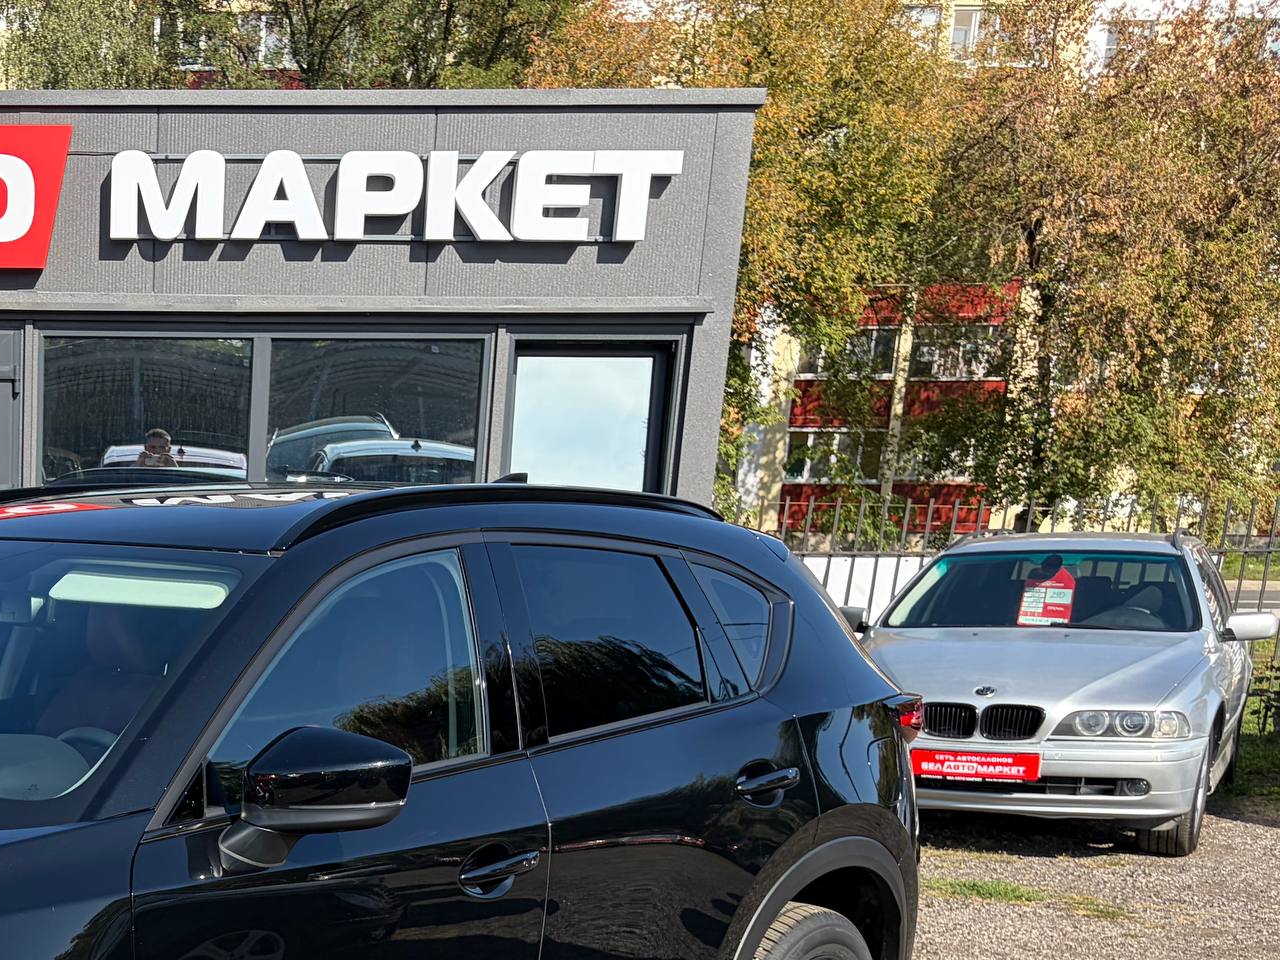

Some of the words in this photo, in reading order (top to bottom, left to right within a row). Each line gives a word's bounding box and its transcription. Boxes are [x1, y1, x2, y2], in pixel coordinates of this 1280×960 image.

[110, 149, 684, 242] МАРКЕТ
[956, 755, 1013, 763] АВТОСАЛОНОВ
[921, 762, 942, 771] БЕЛ
[945, 762, 975, 771] АВТО
[977, 765, 1025, 775] МАРКЕТ
